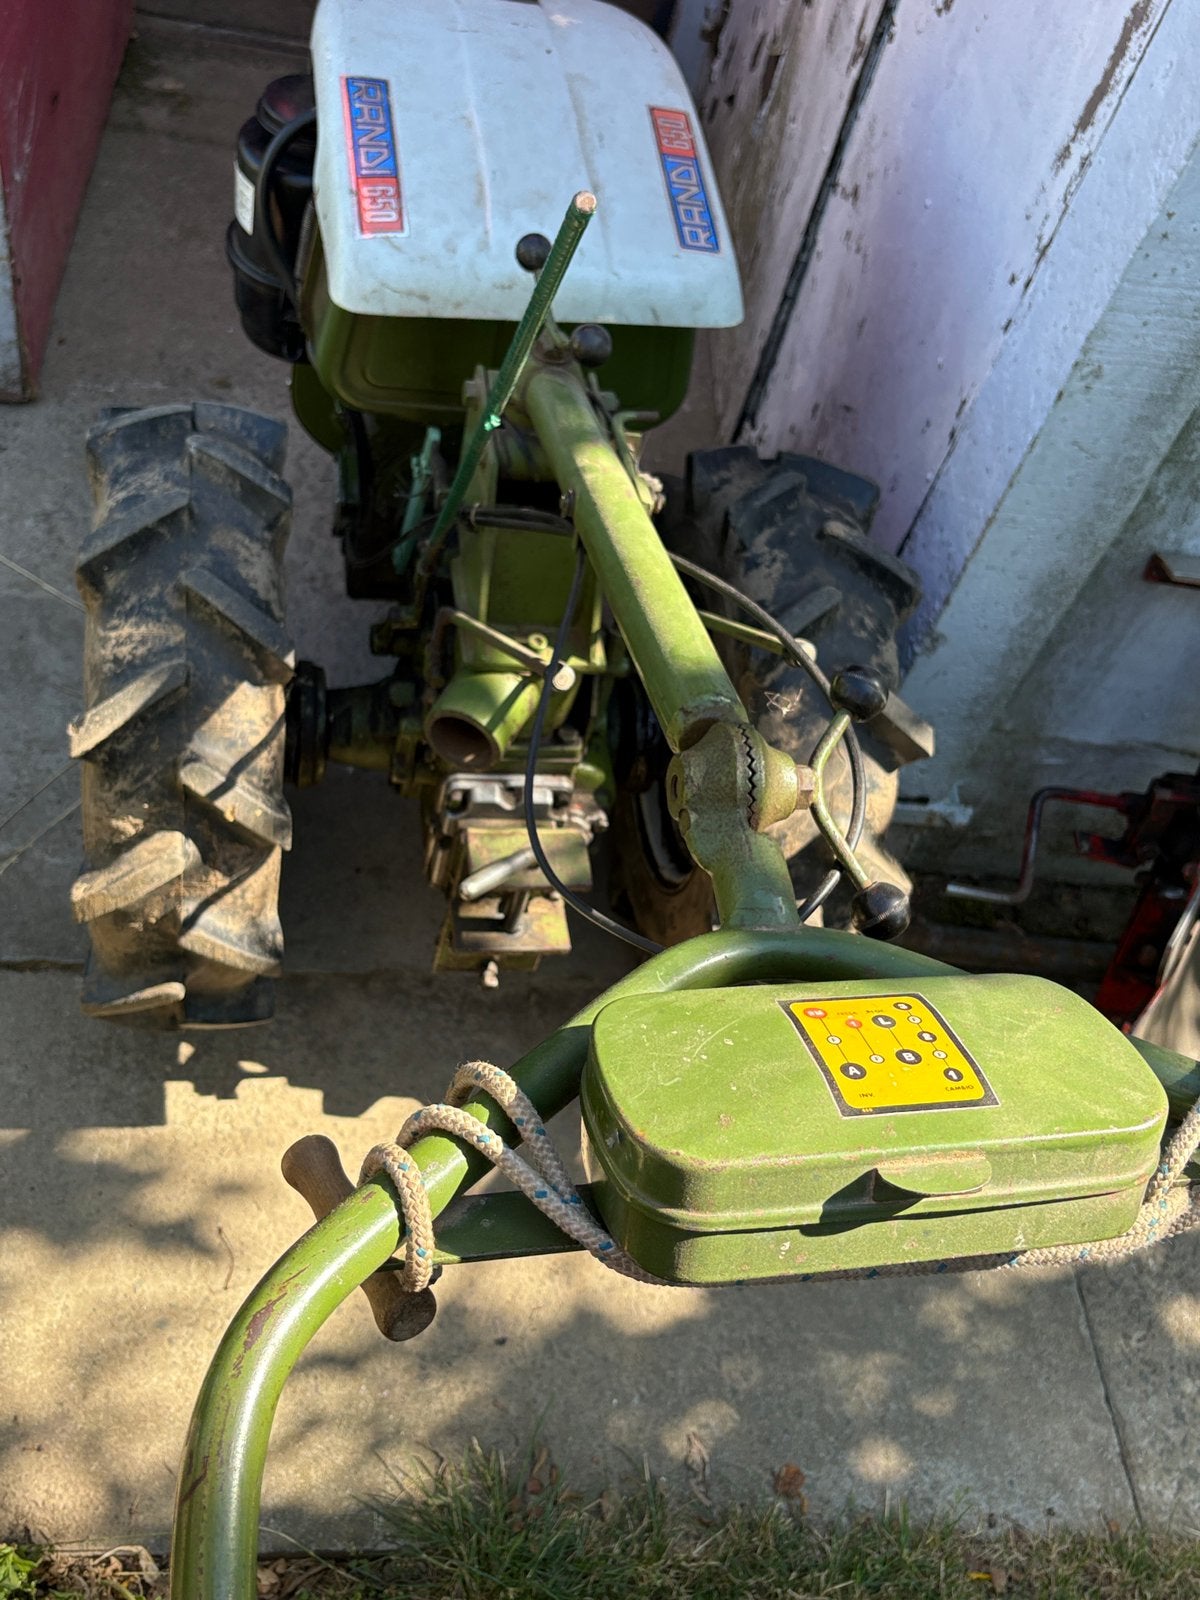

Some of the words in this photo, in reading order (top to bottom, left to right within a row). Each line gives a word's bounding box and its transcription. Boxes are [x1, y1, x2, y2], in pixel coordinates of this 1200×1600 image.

[352, 80, 392, 175] RANDI
[658, 118, 690, 150] 650
[362, 185, 399, 223] 650
[666, 155, 713, 249] RANDI
[879, 1017, 892, 1025] L
[902, 1052, 915, 1061] B
[848, 1066, 860, 1076] A
[948, 1070, 958, 1080] 1
